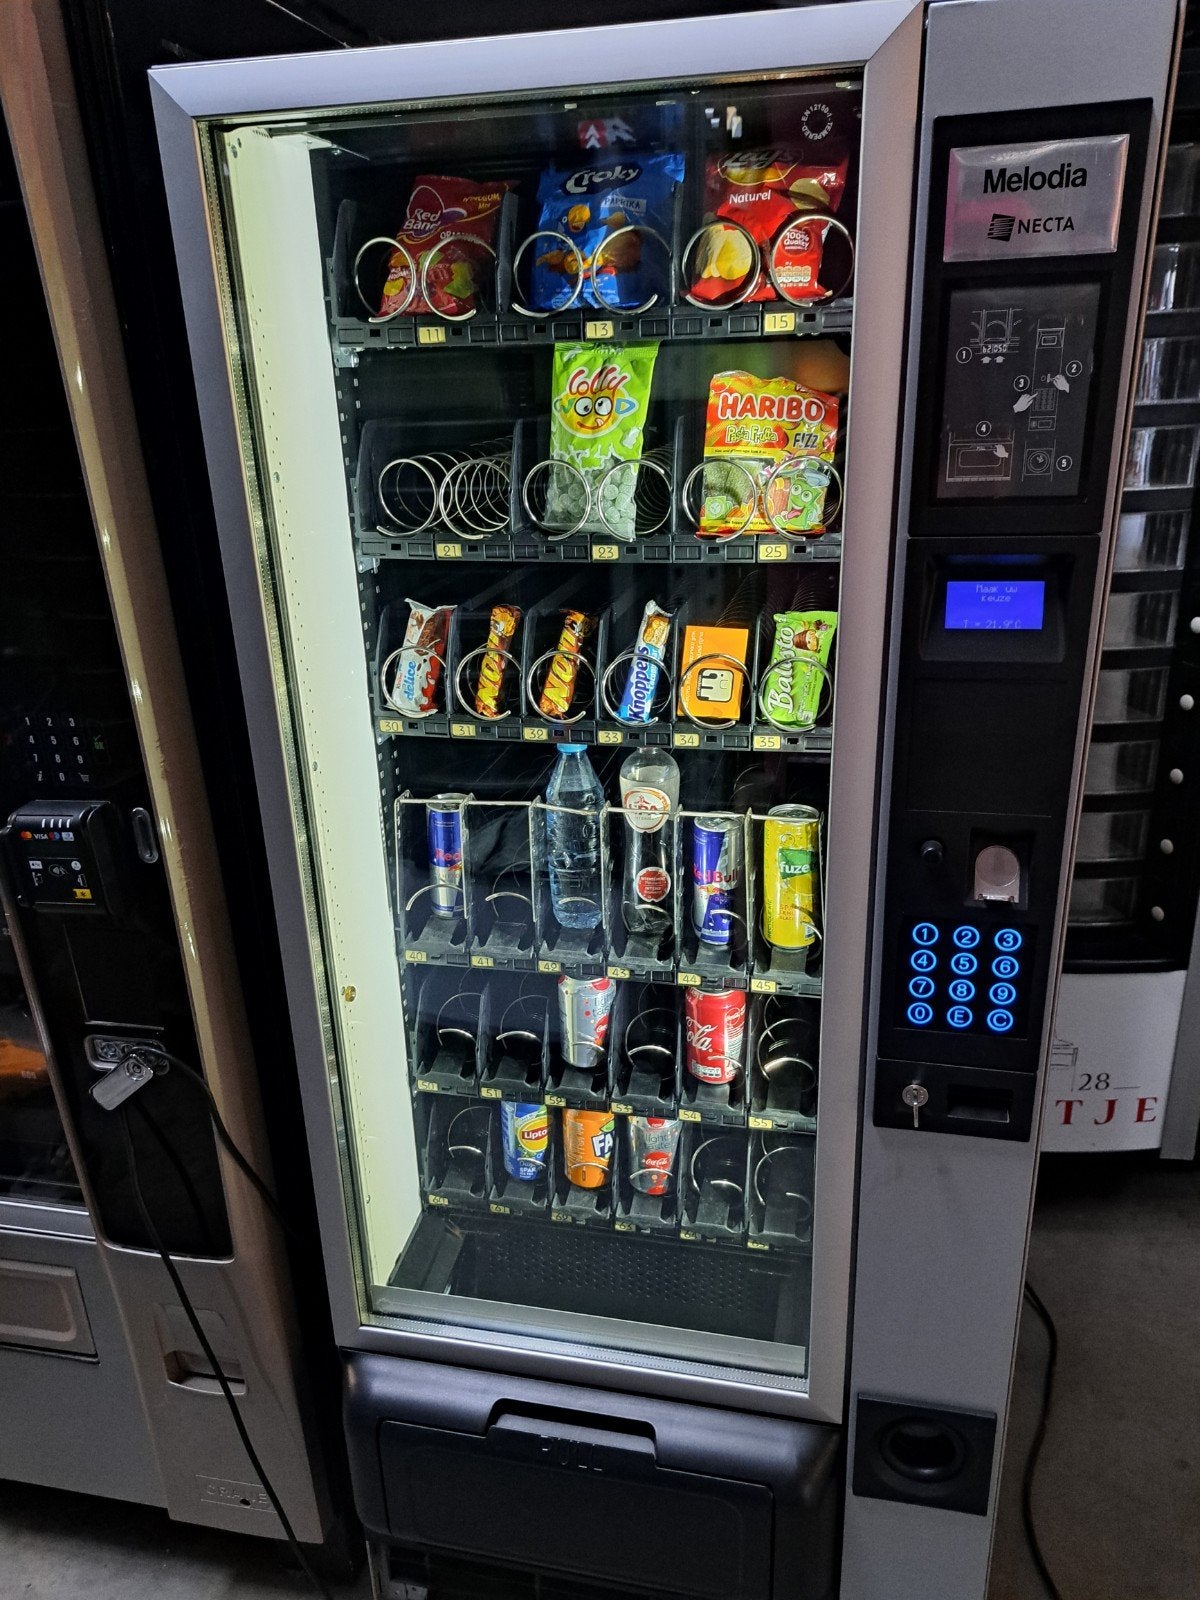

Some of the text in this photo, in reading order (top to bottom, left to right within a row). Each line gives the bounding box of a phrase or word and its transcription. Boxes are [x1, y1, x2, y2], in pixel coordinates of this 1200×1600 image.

[566, 165, 639, 194] Croky
[983, 163, 1087, 194] Melodia
[728, 189, 772, 205] Naturel
[413, 209, 441, 222] Red
[1017, 216, 1075, 234] NECTA
[771, 315, 788, 329] 15
[426, 328, 440, 338] 11
[593, 323, 608, 336] 13
[718, 393, 825, 423] HARIBO
[443, 545, 457, 557] 21
[598, 546, 614, 559] 23
[765, 545, 782, 558] 25
[766, 627, 797, 714] Balisto
[627, 645, 650, 722] Knoppers
[384, 721, 399, 731] 30
[458, 723, 472, 735] 31
[529, 728, 544, 740] 32
[604, 732, 619, 743] 33
[679, 733, 695, 746] 34
[759, 736, 776, 747] 35
[779, 861, 810, 874] fuze
[712, 868, 738, 883] Bull
[921, 927, 1014, 947] 1 2 3
[409, 951, 423, 961] 40
[477, 957, 490, 966] 41
[543, 962, 557, 971] 42
[917, 954, 1011, 974] 4 5 6
[612, 968, 627, 978] 43
[682, 974, 698, 984] 44
[756, 981, 771, 991] 45
[916, 980, 1009, 1000] 7 8 9
[914, 1006, 1007, 1027] 0 E C
[1078, 1072, 1111, 1091] 28
[486, 1088, 498, 1096] 51
[683, 1111, 698, 1119] 54
[753, 1118, 768, 1127] 55
[524, 1129, 548, 1140] Lipto
